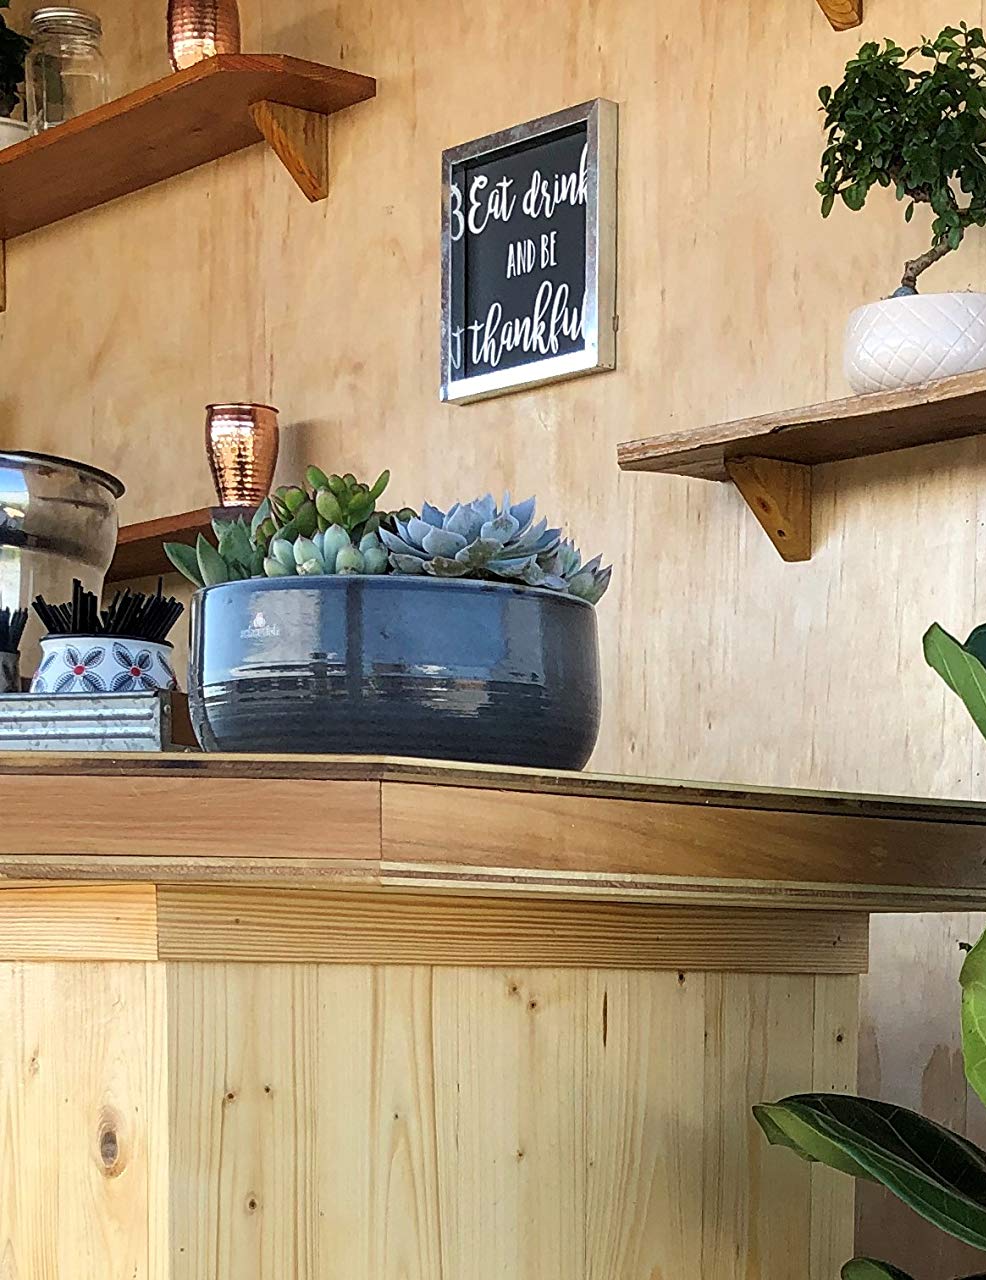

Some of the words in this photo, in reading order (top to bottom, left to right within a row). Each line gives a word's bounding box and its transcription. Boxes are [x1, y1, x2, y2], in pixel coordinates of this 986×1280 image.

[467, 174, 517, 235] Eat
[522, 141, 588, 219] drink
[506, 239, 536, 279] AND
[540, 230, 558, 269] BE
